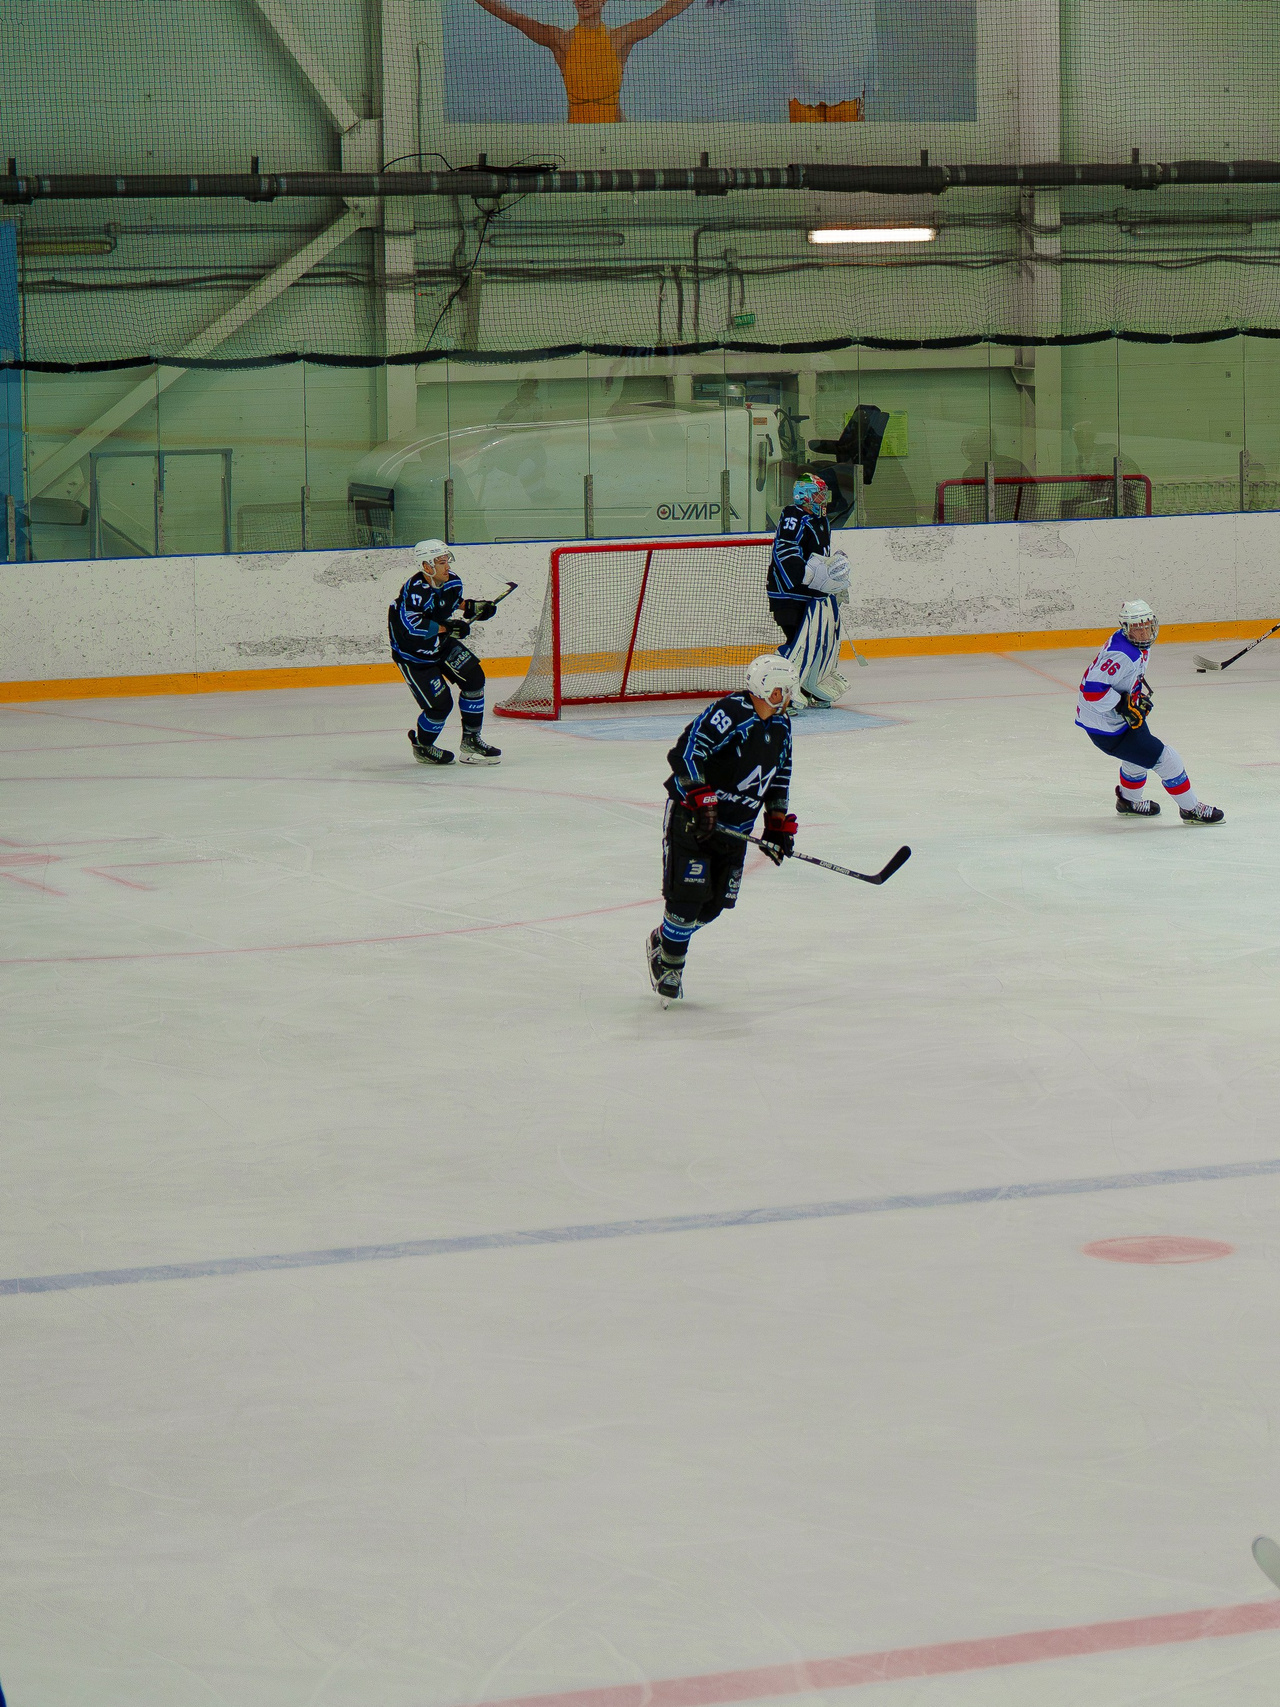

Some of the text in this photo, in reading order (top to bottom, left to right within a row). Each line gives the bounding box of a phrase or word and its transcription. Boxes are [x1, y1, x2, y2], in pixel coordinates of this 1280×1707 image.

[656, 503, 742, 521] OLYMPA
[783, 517, 798, 531] 35
[1100, 658, 1121, 676] 86
[710, 709, 733, 734] 69
